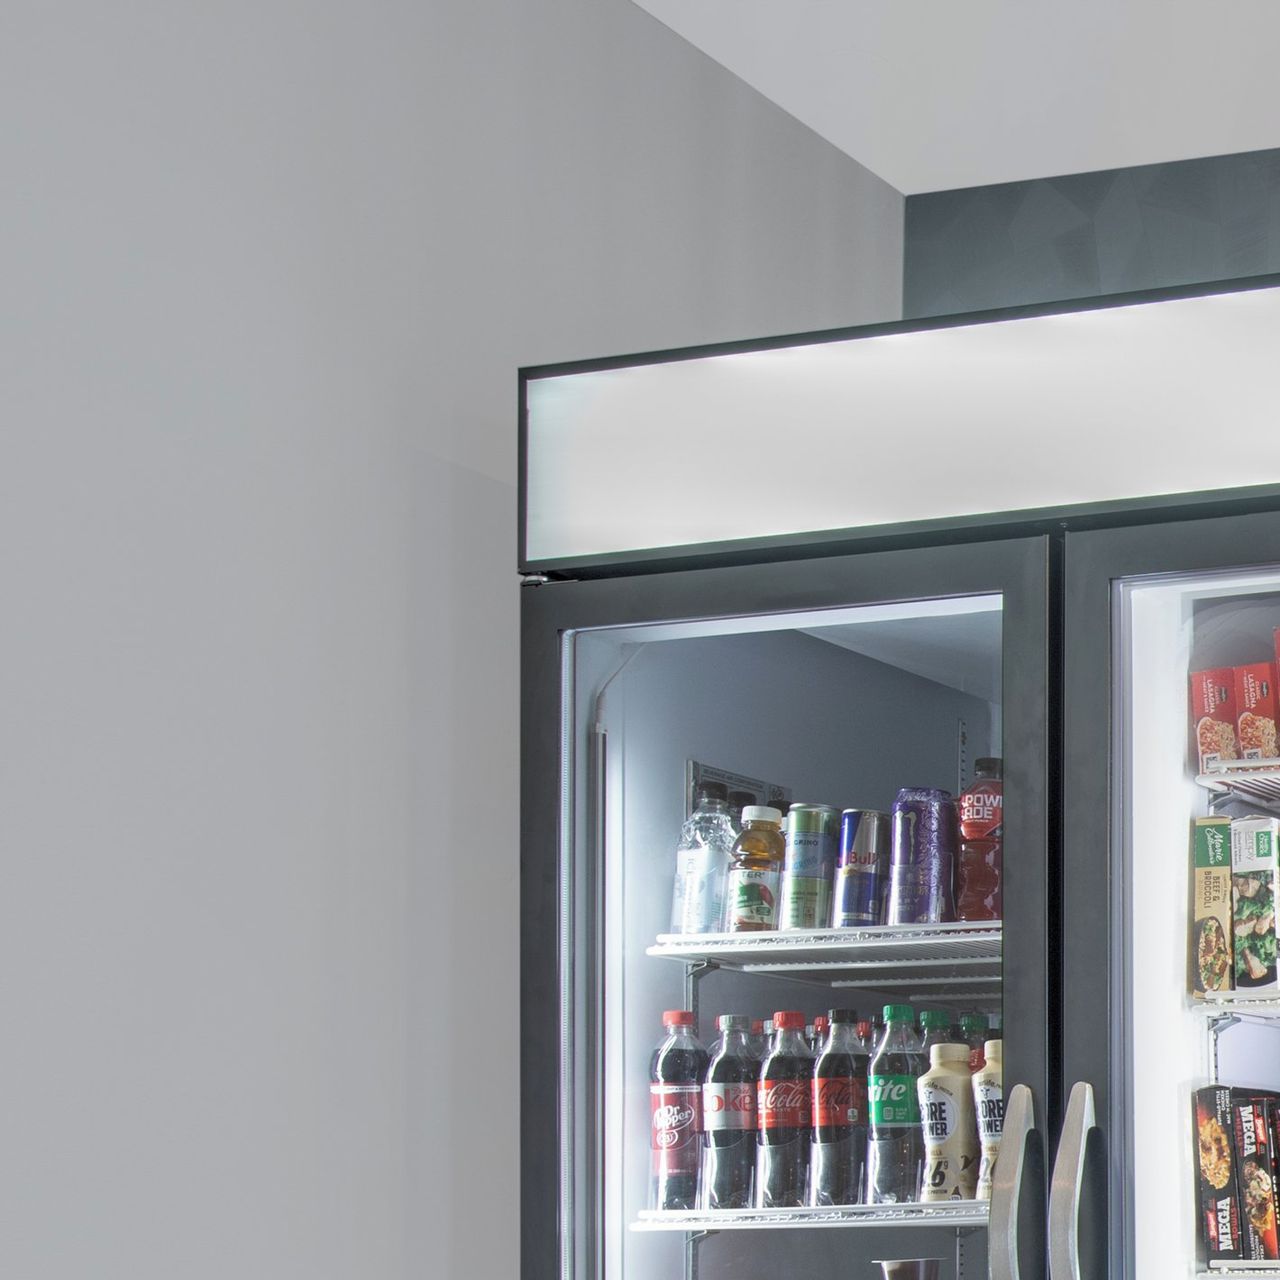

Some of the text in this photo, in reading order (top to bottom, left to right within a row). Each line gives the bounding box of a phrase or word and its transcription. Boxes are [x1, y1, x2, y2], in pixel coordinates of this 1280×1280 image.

[1206, 679, 1216, 715] LASAGNA
[1247, 673, 1257, 710] LASAGNA
[1211, 827, 1225, 863] Marie
[1257, 832, 1266, 857] Choice
[1203, 870, 1213, 909] BROCCOLI
[1212, 875, 1221, 894] BEEF
[767, 1083, 803, 1109] Cola
[1239, 1105, 1257, 1158] MEGA
[1216, 1197, 1234, 1251] MEGA
